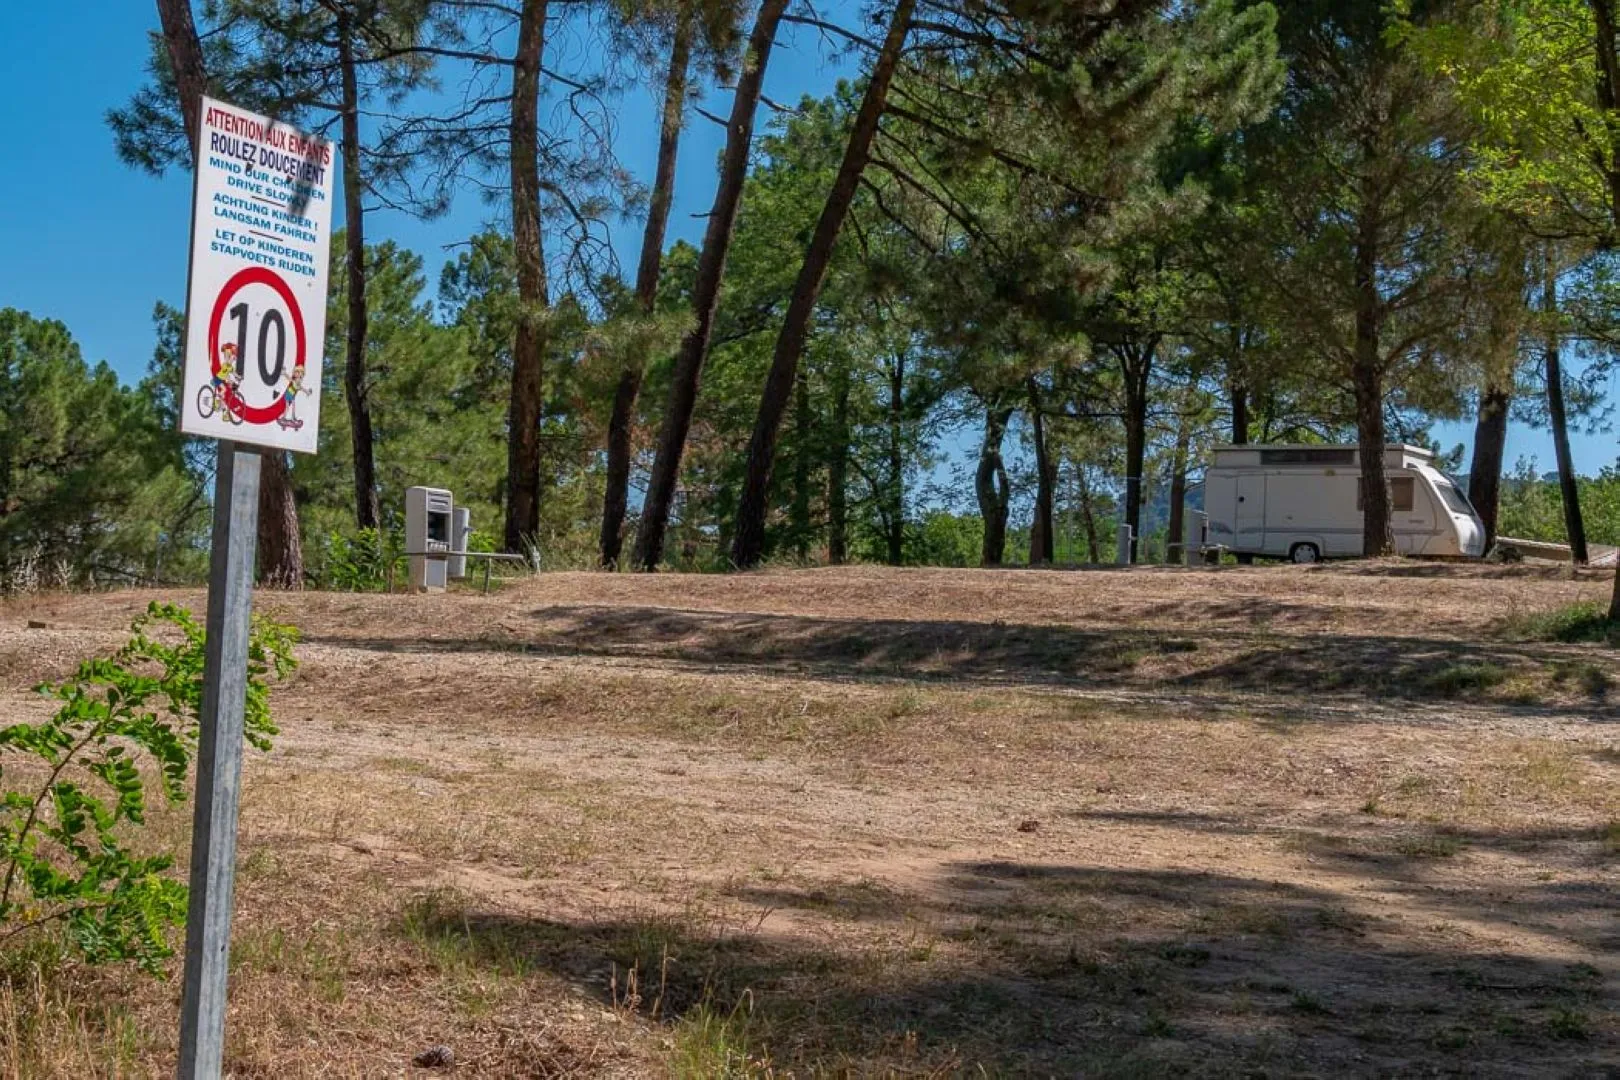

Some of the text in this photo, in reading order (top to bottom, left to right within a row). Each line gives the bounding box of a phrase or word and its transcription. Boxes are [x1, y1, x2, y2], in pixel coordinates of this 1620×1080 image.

[206, 107, 330, 165] ATTENTION AUX ENFANTS
[210, 157, 242, 174] MIND
[211, 132, 325, 186] ROULEZ DOUCEMENT
[227, 175, 262, 194] DRIVE
[213, 192, 269, 216] ACHTUNG
[271, 208, 312, 229] KINDER
[214, 206, 316, 243] LANGSAM FAHREN
[210, 241, 276, 266] STAPVOETS
[215, 229, 313, 263] LET OP KINDEREN
[230, 302, 286, 386] 10
